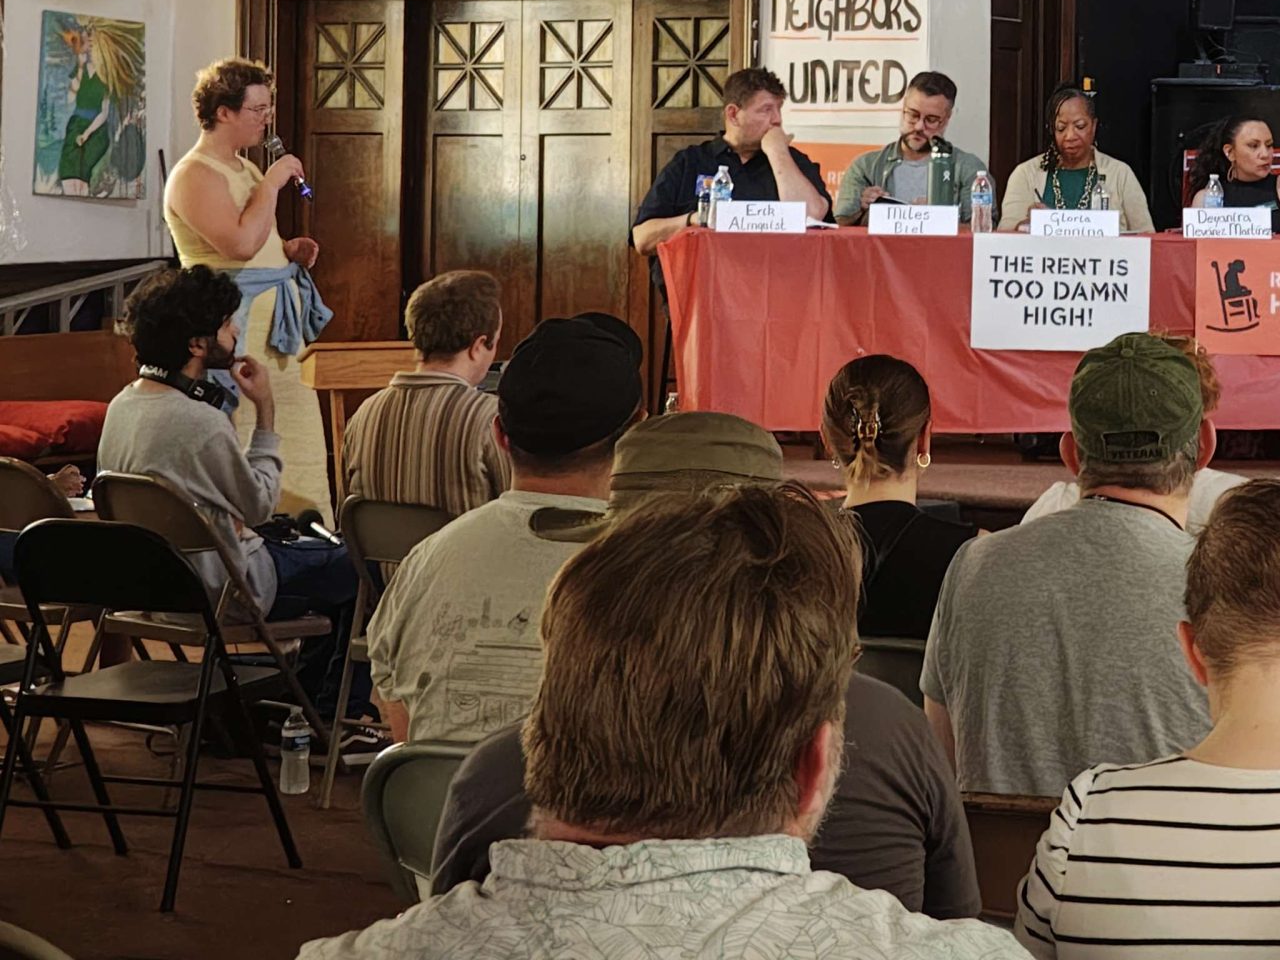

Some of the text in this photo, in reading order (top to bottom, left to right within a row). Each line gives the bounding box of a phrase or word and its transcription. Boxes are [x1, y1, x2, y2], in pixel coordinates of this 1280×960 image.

[789, 59, 908, 104] UNITED
[894, 220, 924, 234] Biel
[1050, 212, 1092, 226] Gloria
[1197, 209, 1252, 227] Deyanira
[990, 255, 1128, 276] THE RENT IS
[989, 279, 1128, 302] TOO DAMN
[1023, 306, 1093, 327] HIGH!
